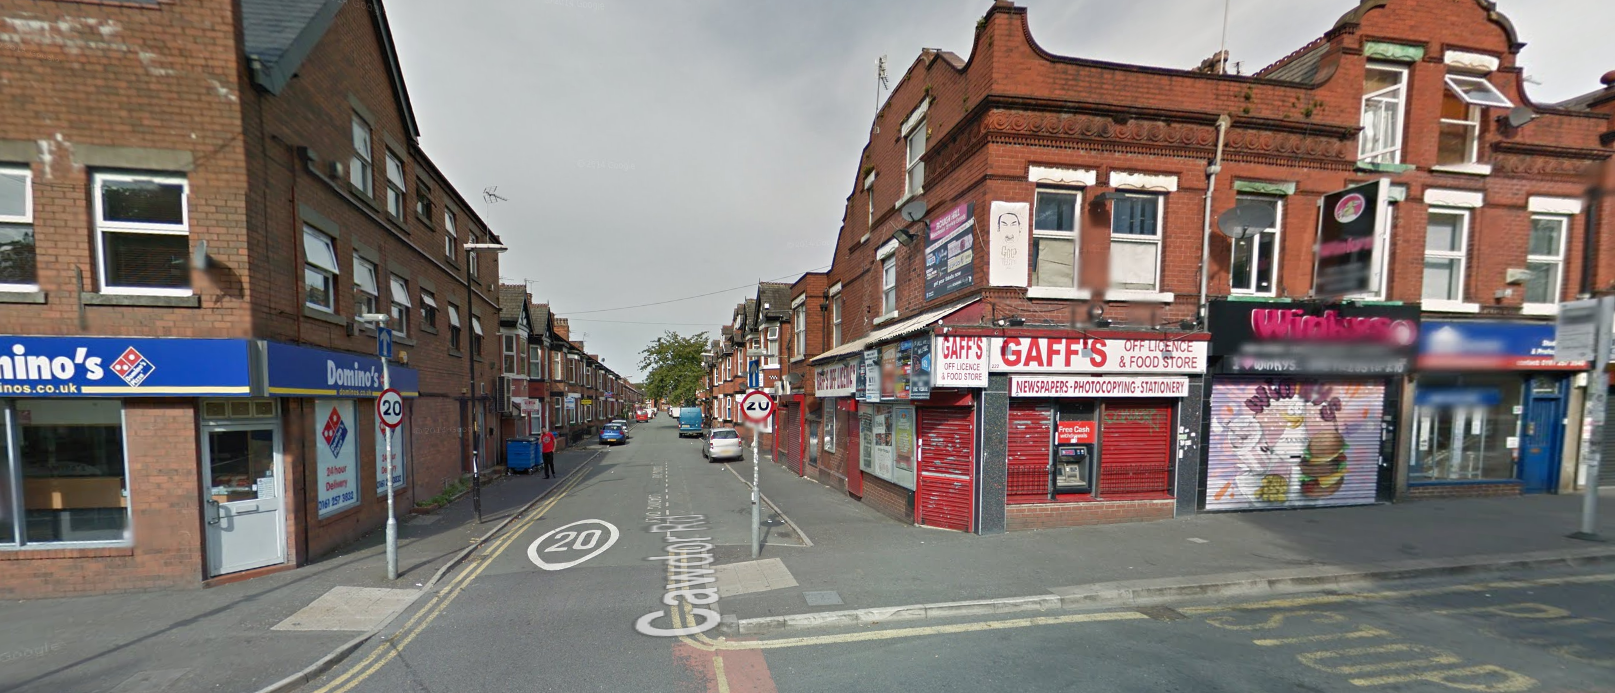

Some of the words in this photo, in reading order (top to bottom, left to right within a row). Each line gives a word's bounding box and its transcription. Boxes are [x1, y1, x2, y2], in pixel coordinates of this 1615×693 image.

[941, 336, 984, 360] GAFF'S
[1000, 336, 1107, 368] GAFF'S
[1124, 340, 1146, 353] OFF
[1148, 340, 1193, 354] LICENCE
[944, 362, 955, 371] OFF
[956, 362, 980, 371] LICENCE
[1118, 357, 1127, 368] &
[1129, 356, 1160, 369] FOOD
[1162, 356, 1197, 369] STORE
[326, 359, 379, 388] Domino's
[947, 372, 963, 381] FOOD
[964, 372, 983, 381] STORE
[338, 388, 373, 397] dominos.co.uk
[1016, 380, 1070, 394] NEWSPAPERS
[1073, 380, 1137, 395] PHOTOCOPYING
[1139, 380, 1185, 395] STATIONERY
[382, 400, 402, 416] 20
[1058, 425, 1073, 433] Free
[1074, 425, 1090, 433] Cash
[334, 464, 347, 475] hour
[381, 464, 397, 475] Dery
[325, 479, 348, 492] Delivery
[331, 495, 341, 507] 257
[342, 490, 354, 503] 3832
[544, 529, 602, 553] 20
